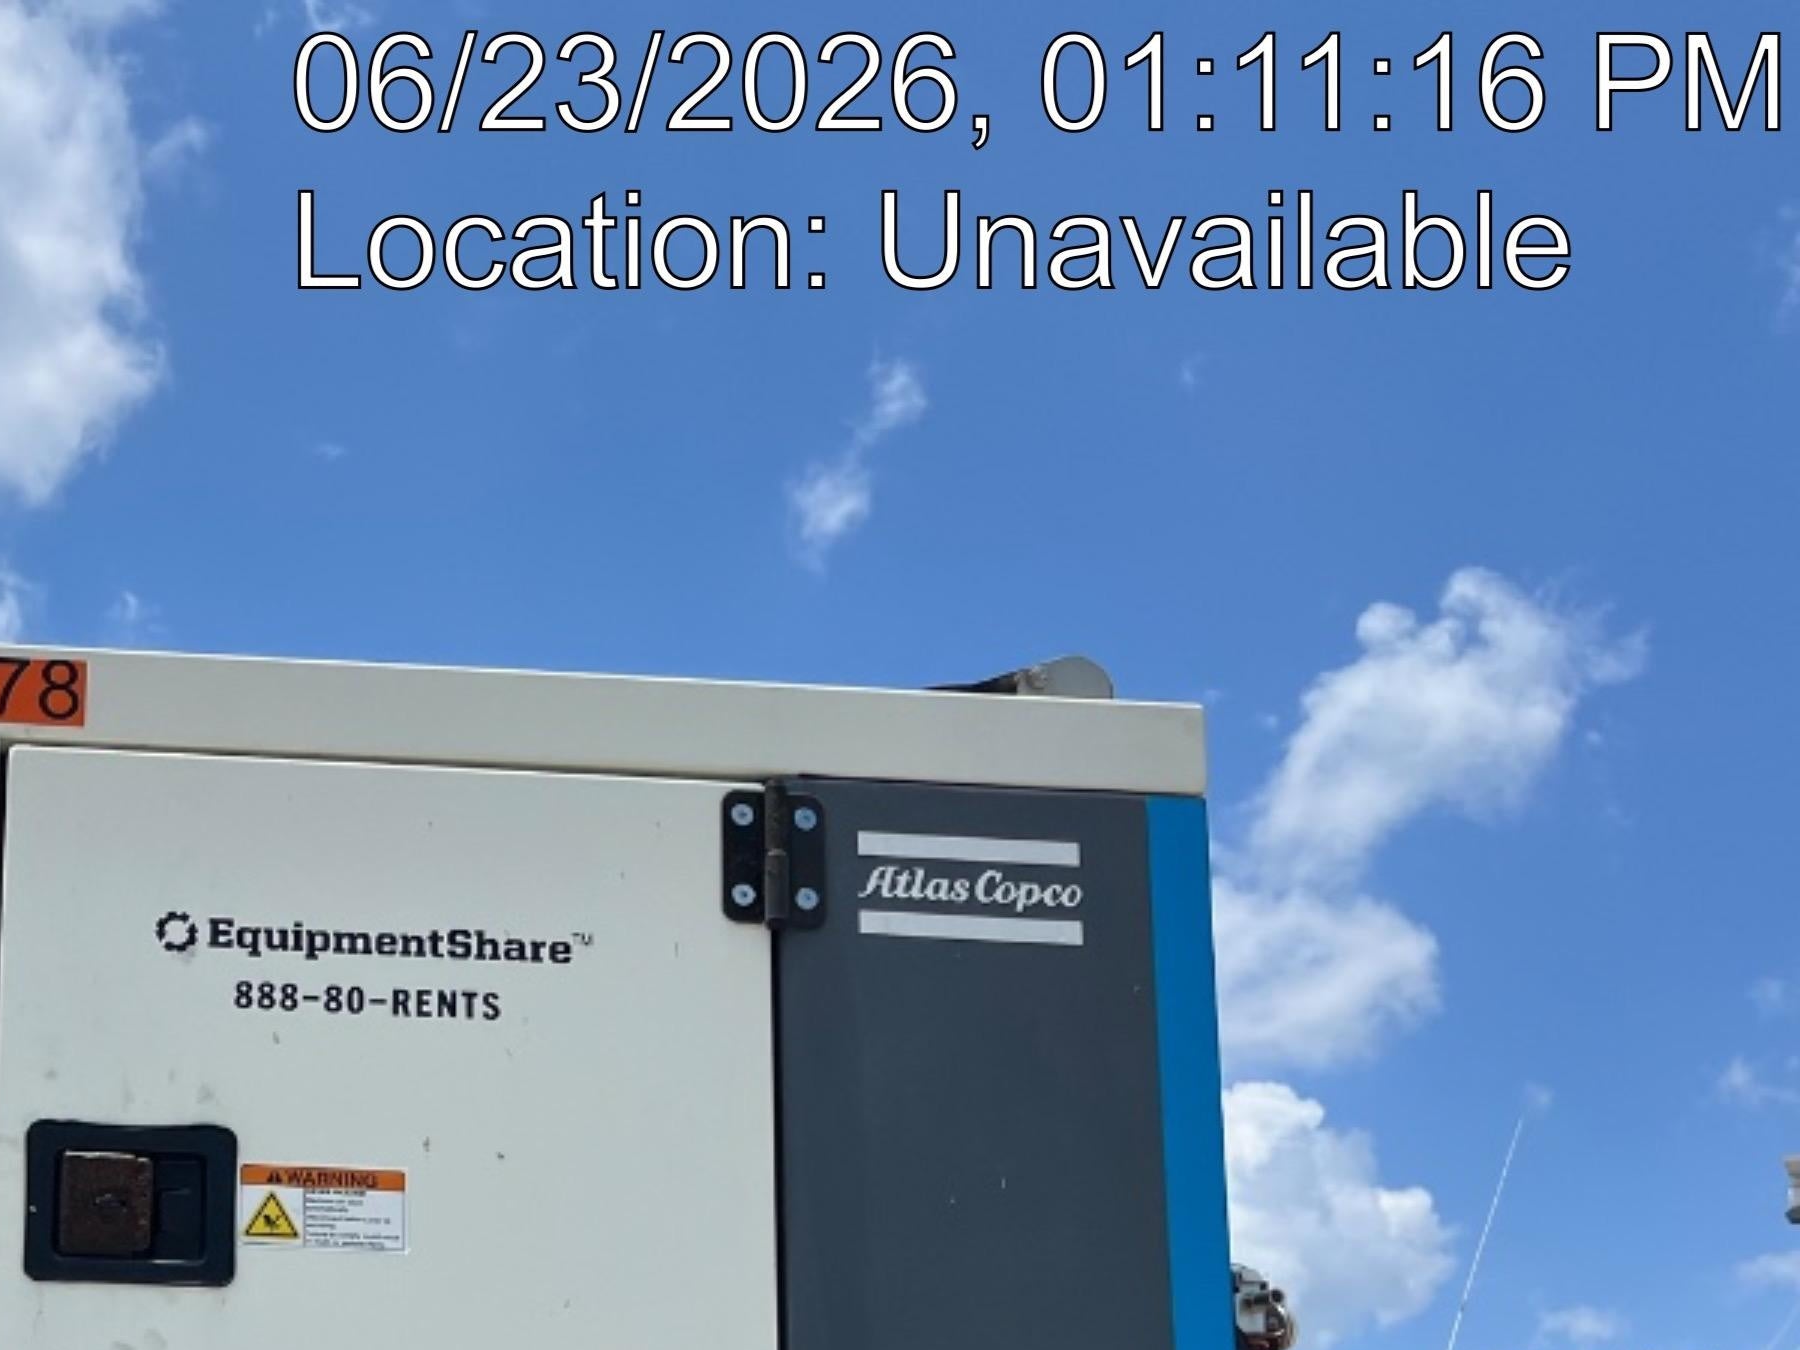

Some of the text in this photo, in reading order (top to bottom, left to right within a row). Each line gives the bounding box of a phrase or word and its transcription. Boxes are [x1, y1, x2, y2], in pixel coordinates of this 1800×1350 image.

[857, 865, 1084, 913] Atlas Copco
[234, 980, 502, 1021] 888-80-RENTS
[286, 1169, 379, 1189] WARNING
